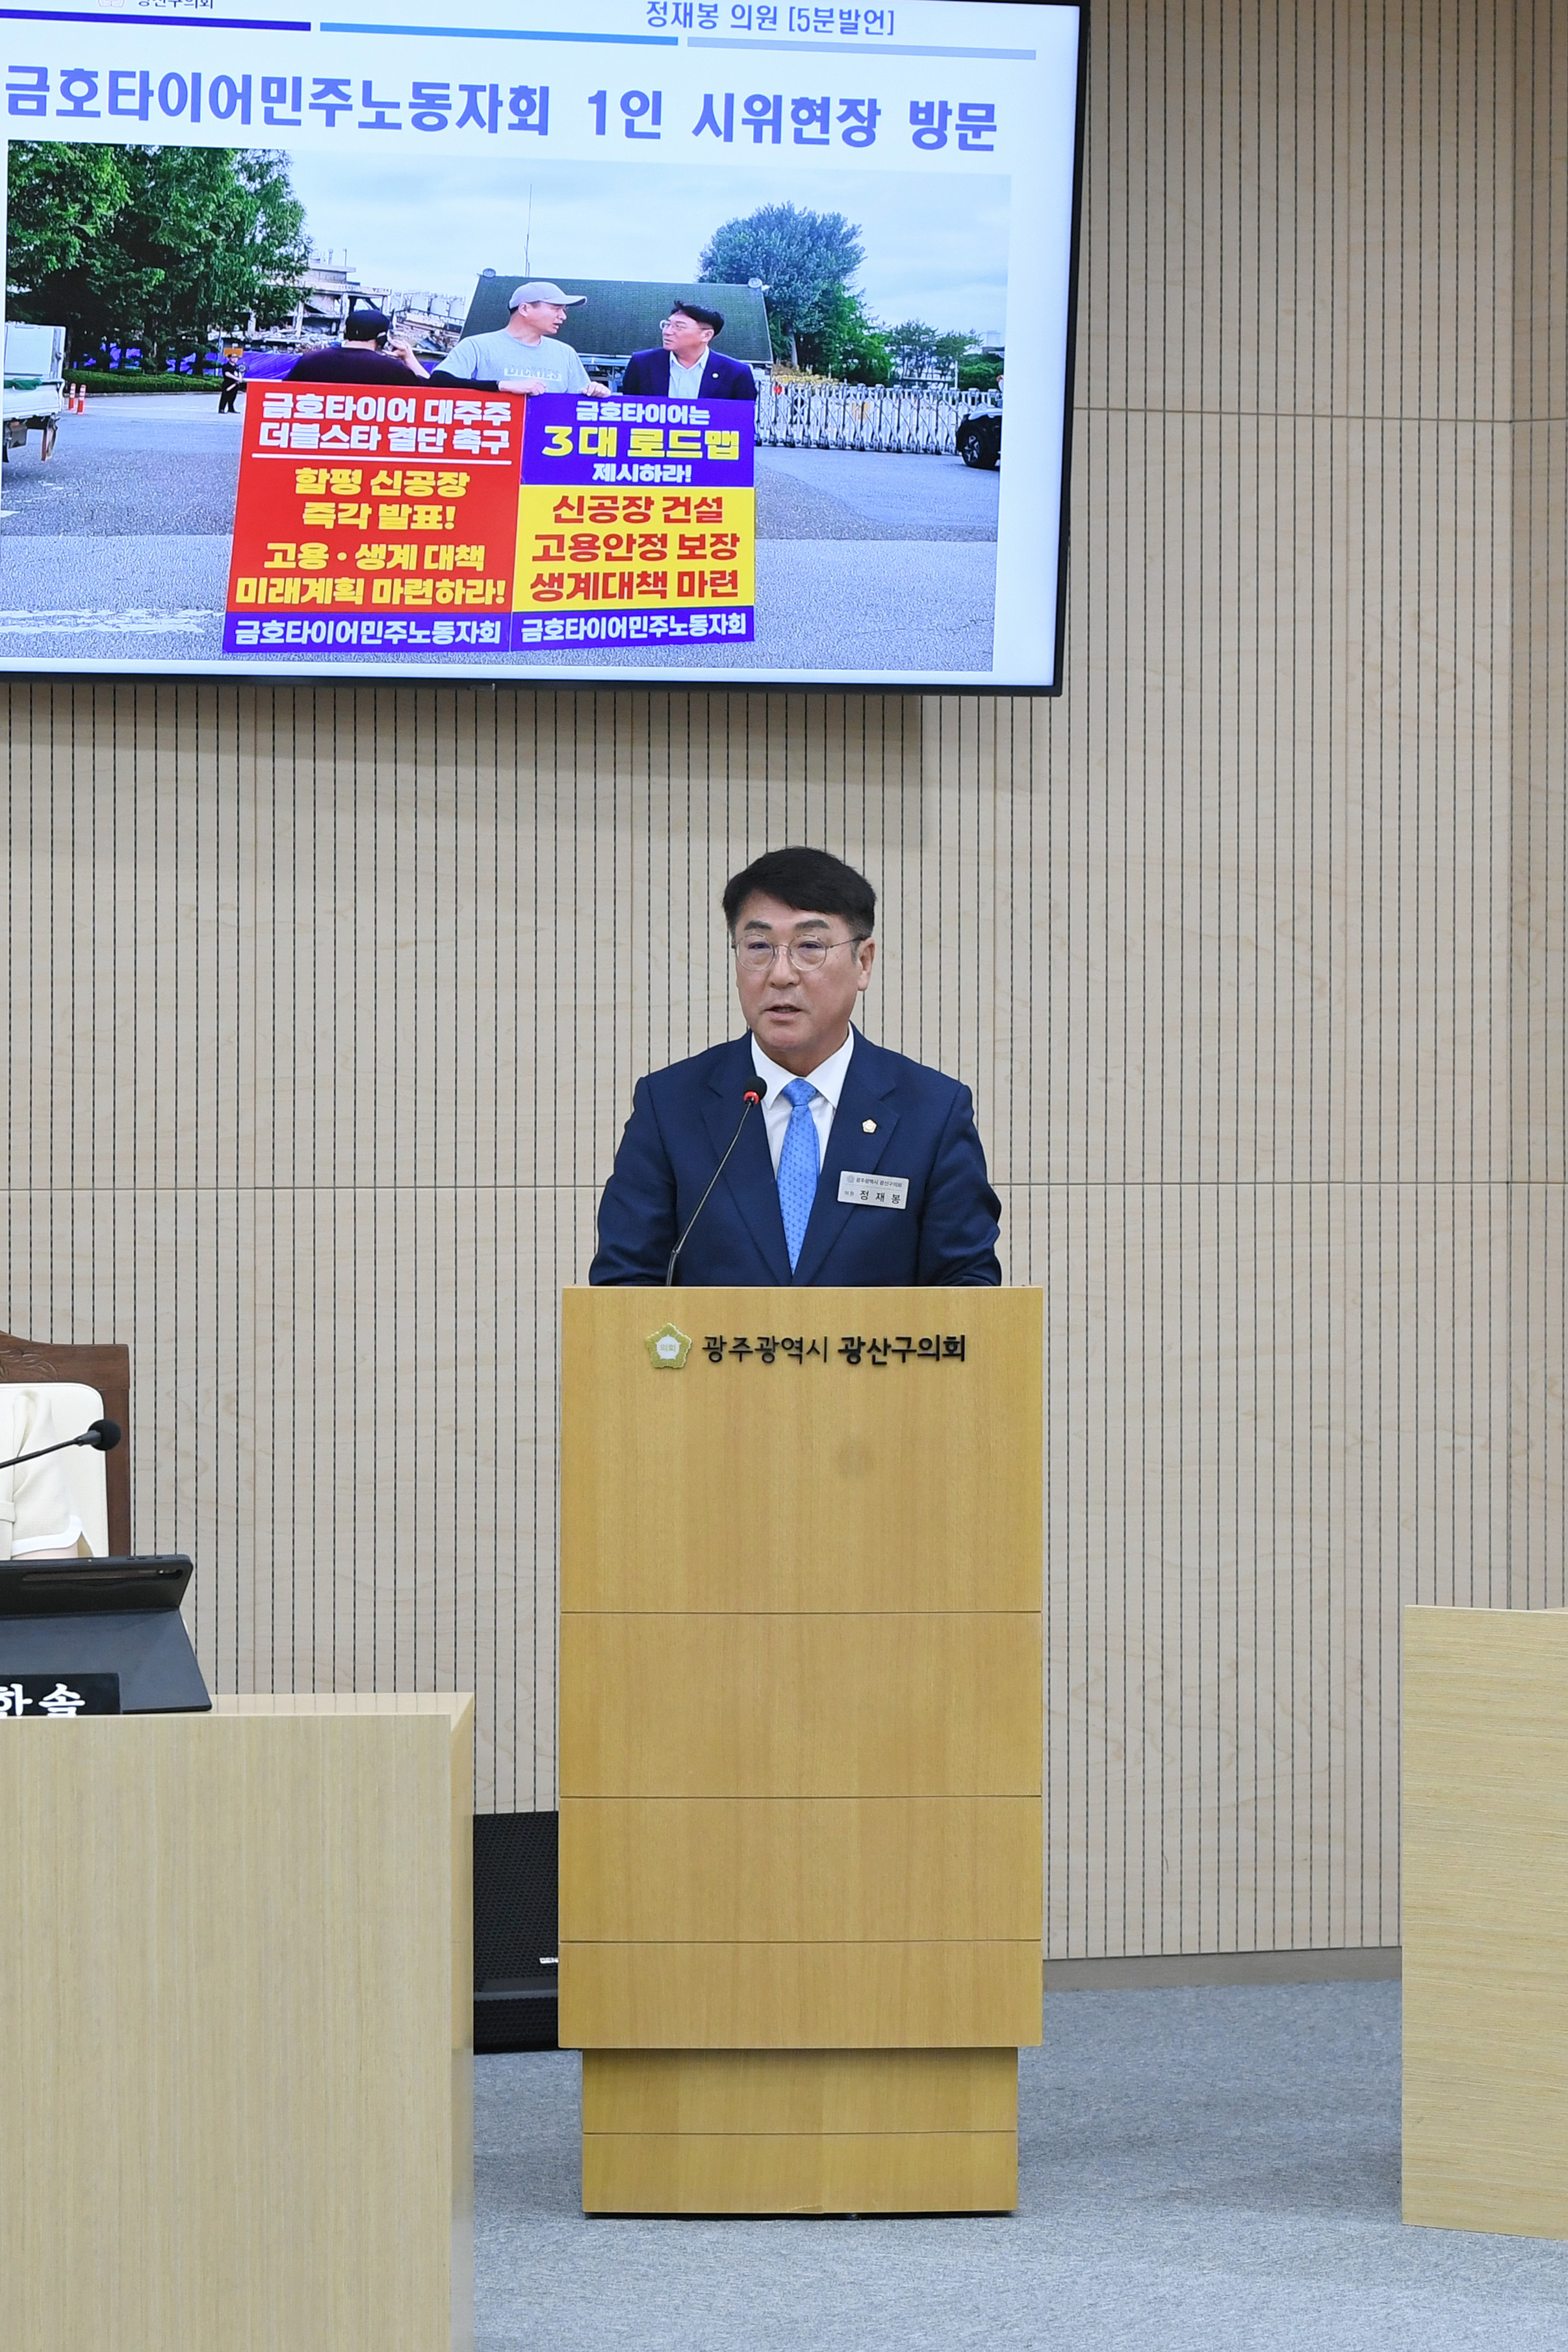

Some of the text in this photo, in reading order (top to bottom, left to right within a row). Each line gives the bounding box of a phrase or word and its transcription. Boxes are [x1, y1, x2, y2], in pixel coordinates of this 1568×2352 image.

[646, 1, 895, 36] 정재봉 의원 [5분발언]
[5, 65, 997, 152] 금호타이어민주노동자회 1인 시위현장 방문
[262, 392, 512, 426] 금호타이어 대주주
[575, 400, 711, 426] 금호타이어는
[259, 422, 510, 455] 더블스타 결단 촉구
[627, 428, 740, 460] 로드맵
[294, 467, 470, 498] 함평 신공장
[592, 463, 693, 483] 제시하라!
[302, 502, 456, 530] 즉각 발표!
[552, 495, 723, 524] 신공장 건설
[424, 545, 485, 572] 대책
[532, 532, 741, 563] 고용안정 보장
[235, 576, 506, 605] 미래계획 마련하라!
[530, 569, 738, 602] 생계대책 마련
[235, 620, 501, 645] 금호타이어민주노동자회
[521, 612, 747, 643] 금호타이어민주노동자회
[660, 1343, 676, 1352] 의회
[702, 1334, 966, 1365] 광주광역시 광산구의회
